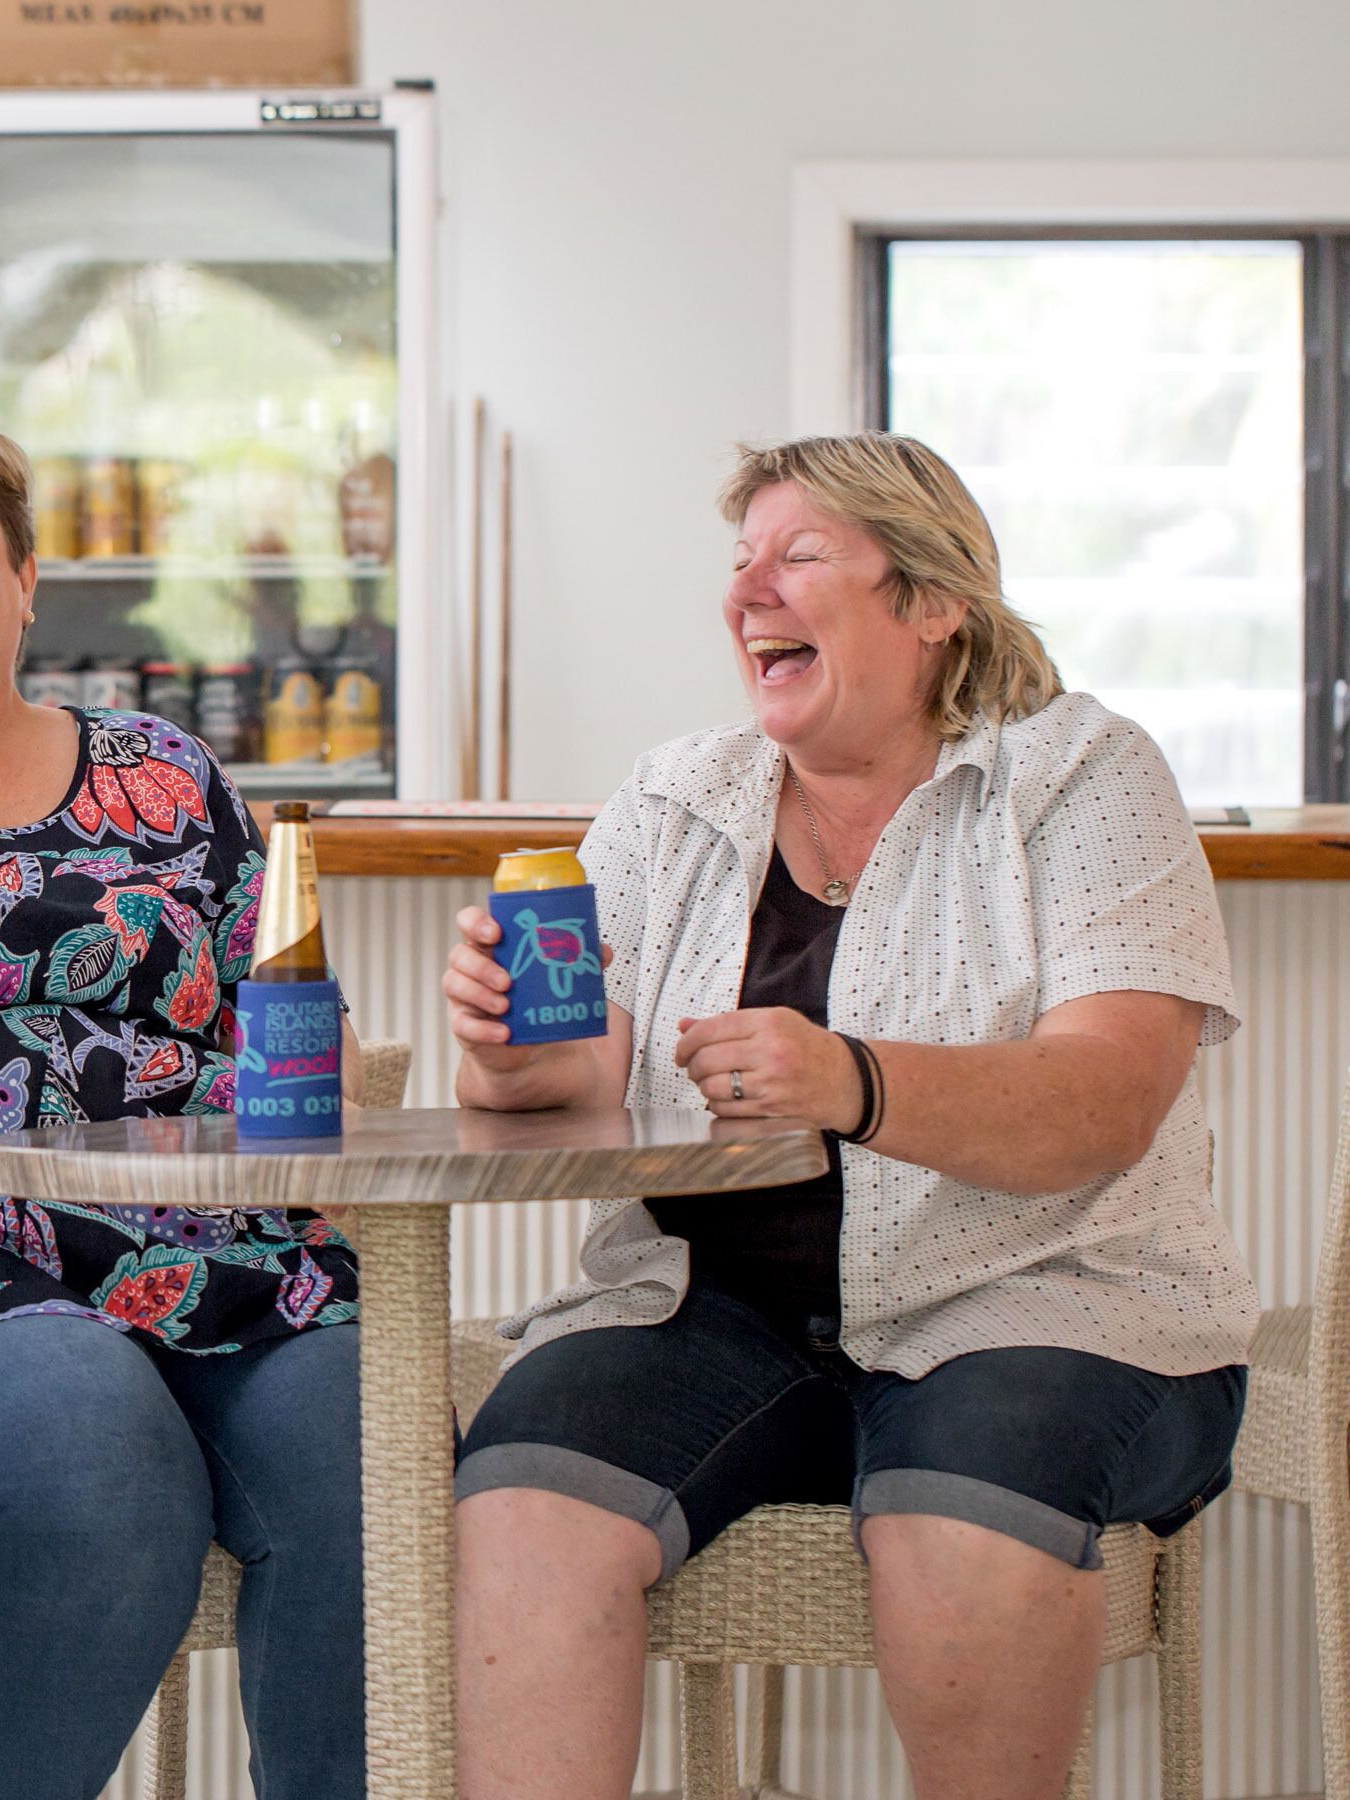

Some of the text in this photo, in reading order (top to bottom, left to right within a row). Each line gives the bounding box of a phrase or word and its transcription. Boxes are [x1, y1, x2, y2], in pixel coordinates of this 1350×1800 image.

[265, 1001, 337, 1016] SOLITARY
[523, 1002, 588, 1026] 1800
[265, 1014, 338, 1032] ISLANDS
[265, 1036, 337, 1054] RESORT
[247, 1096, 296, 1117] 003
[303, 1094, 339, 1116] 031
